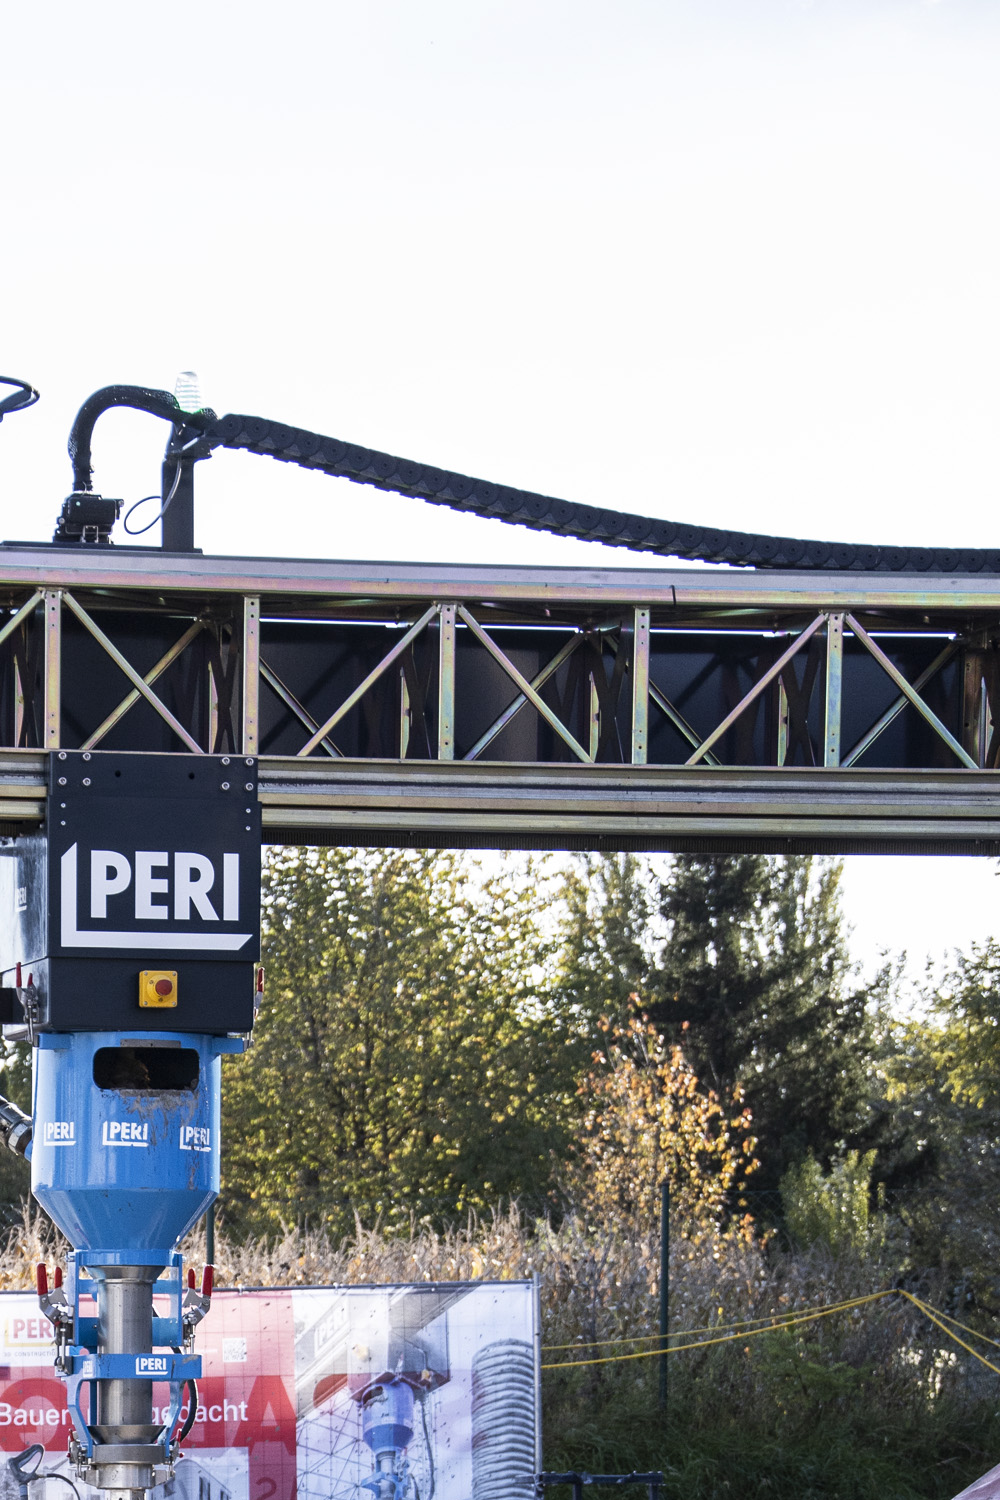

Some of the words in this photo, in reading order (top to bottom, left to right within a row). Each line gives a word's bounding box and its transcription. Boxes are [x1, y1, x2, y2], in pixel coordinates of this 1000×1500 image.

[90, 849, 240, 921] PERI
[47, 1121, 75, 1139] PERI
[109, 1121, 148, 1141] PERI
[185, 1126, 210, 1146] PERI
[13, 1318, 53, 1339] PER
[140, 1357, 167, 1371] PERI
